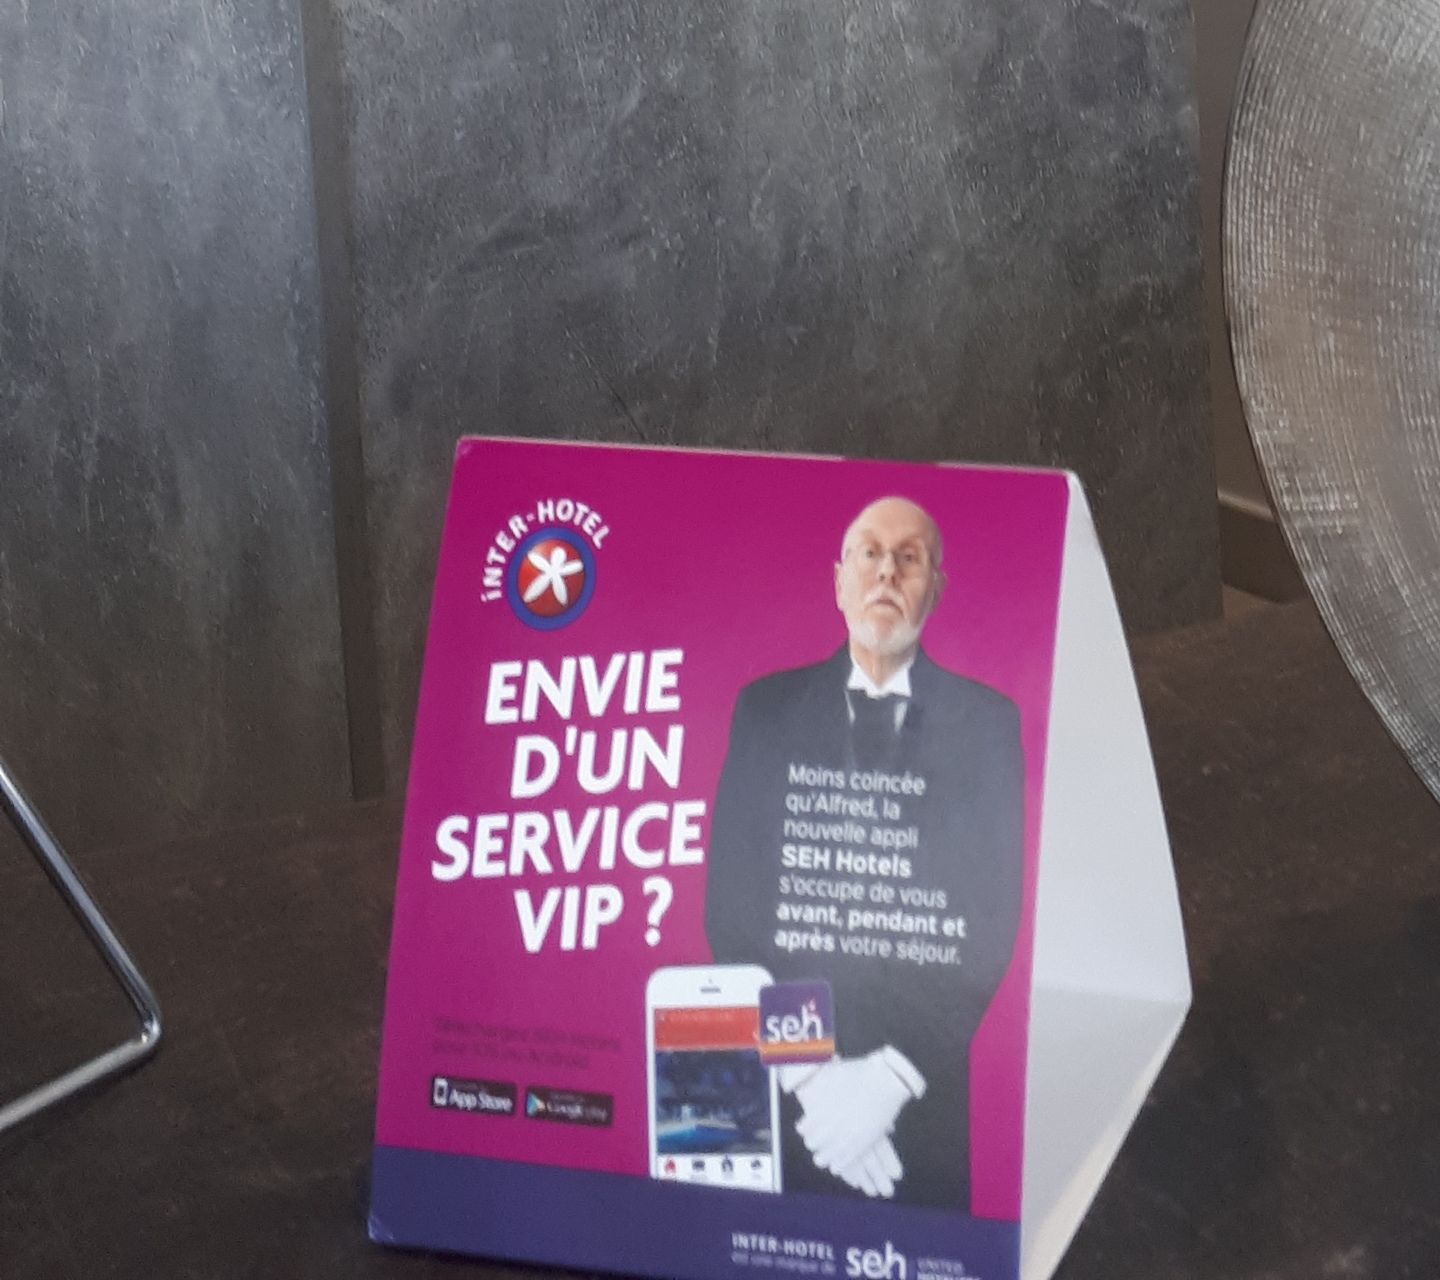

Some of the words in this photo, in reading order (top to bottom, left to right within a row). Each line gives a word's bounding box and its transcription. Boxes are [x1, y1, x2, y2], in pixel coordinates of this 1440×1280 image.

[484, 648, 684, 725] ENVIE
[510, 724, 684, 798] D'UN
[788, 762, 845, 789] Moins
[850, 770, 926, 796] coincée
[883, 798, 900, 820] la
[431, 800, 706, 882] SERVICE
[784, 819, 866, 844] nouvelle
[870, 827, 919, 851] appli
[781, 843, 832, 871] SEH
[835, 849, 912, 879] Hotels
[778, 873, 865, 903] s'occupe
[869, 882, 895, 904] de
[899, 889, 947, 910] vous
[513, 883, 624, 953] VIP
[642, 875, 674, 947] ?
[776, 902, 844, 929] avant,
[848, 908, 938, 936] pendant
[942, 916, 967, 938] et
[774, 927, 836, 953] après
[839, 936, 892, 958] votre
[897, 938, 962, 966] séjour.
[766, 1002, 824, 1045] seh
[449, 1089, 477, 1111] App
[478, 1090, 513, 1113] Store
[846, 1240, 907, 1280] seh
